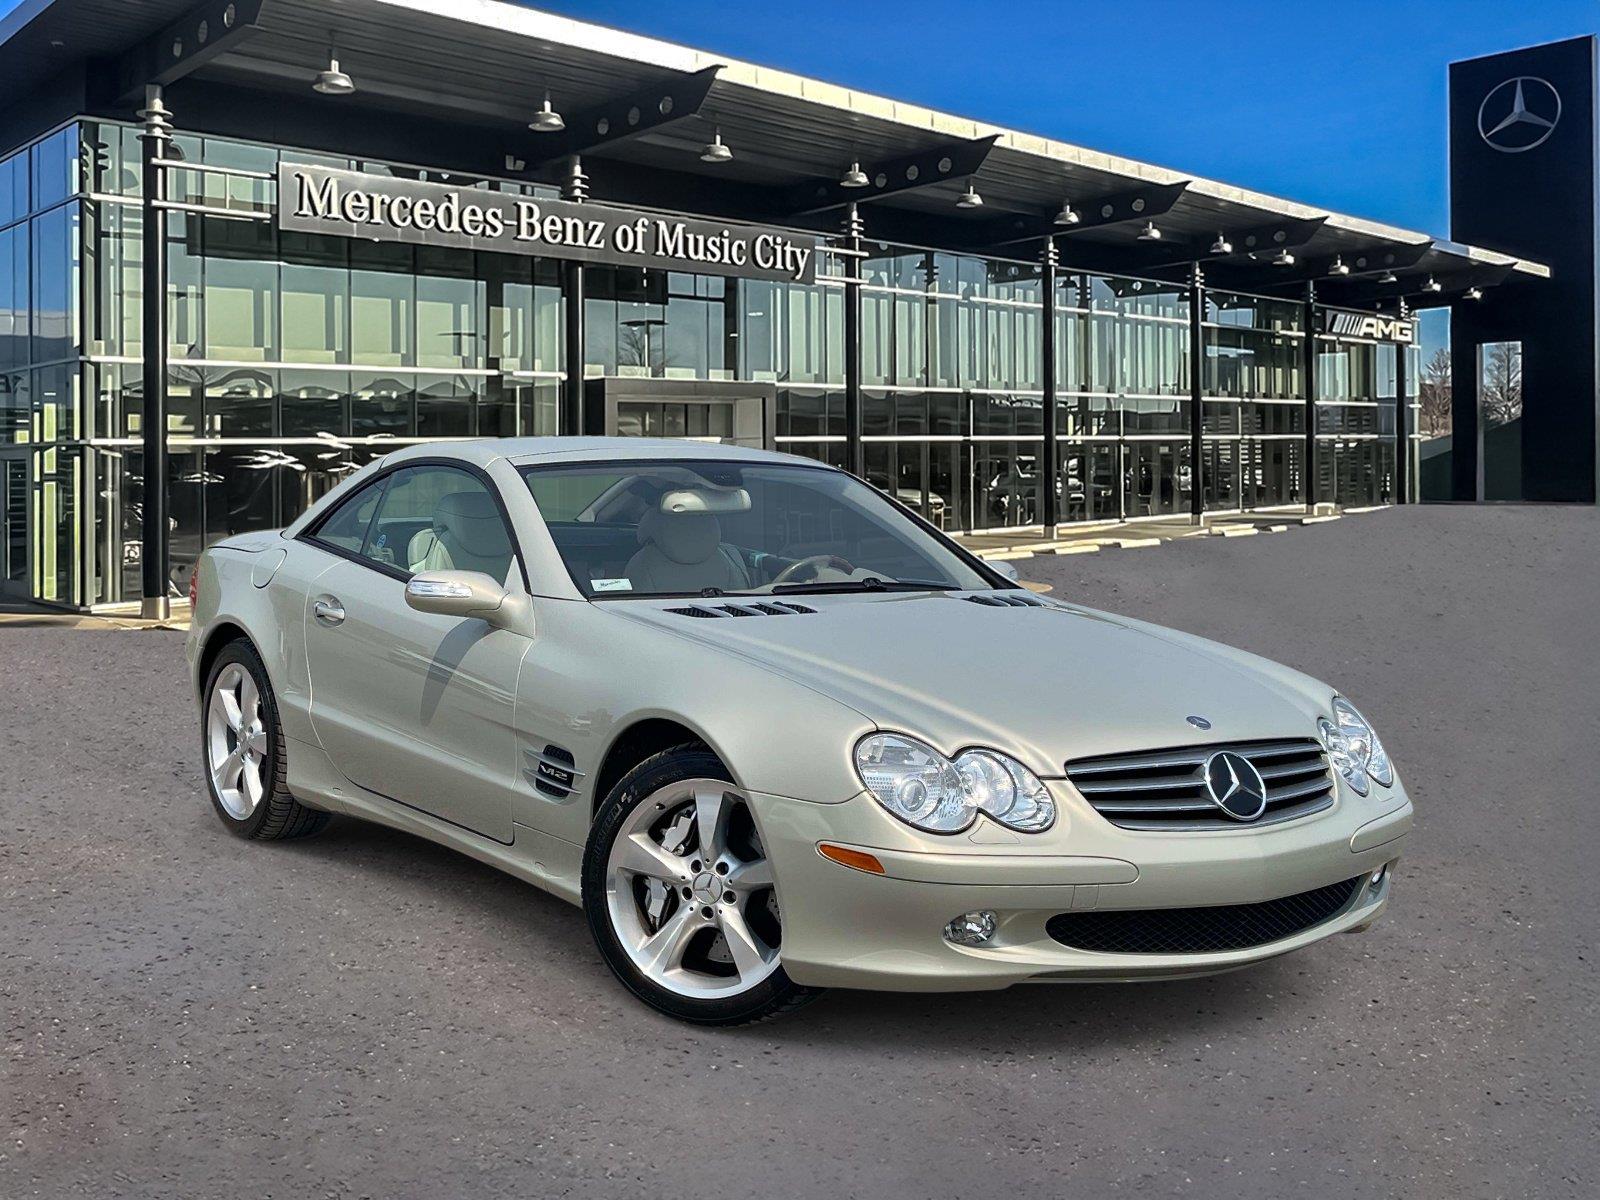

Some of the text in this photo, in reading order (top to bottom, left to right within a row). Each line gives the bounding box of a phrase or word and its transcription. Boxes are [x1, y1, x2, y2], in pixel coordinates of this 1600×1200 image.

[295, 172, 811, 280] Mercedes-Benz of Music City
[1359, 317, 1413, 342] AMG
